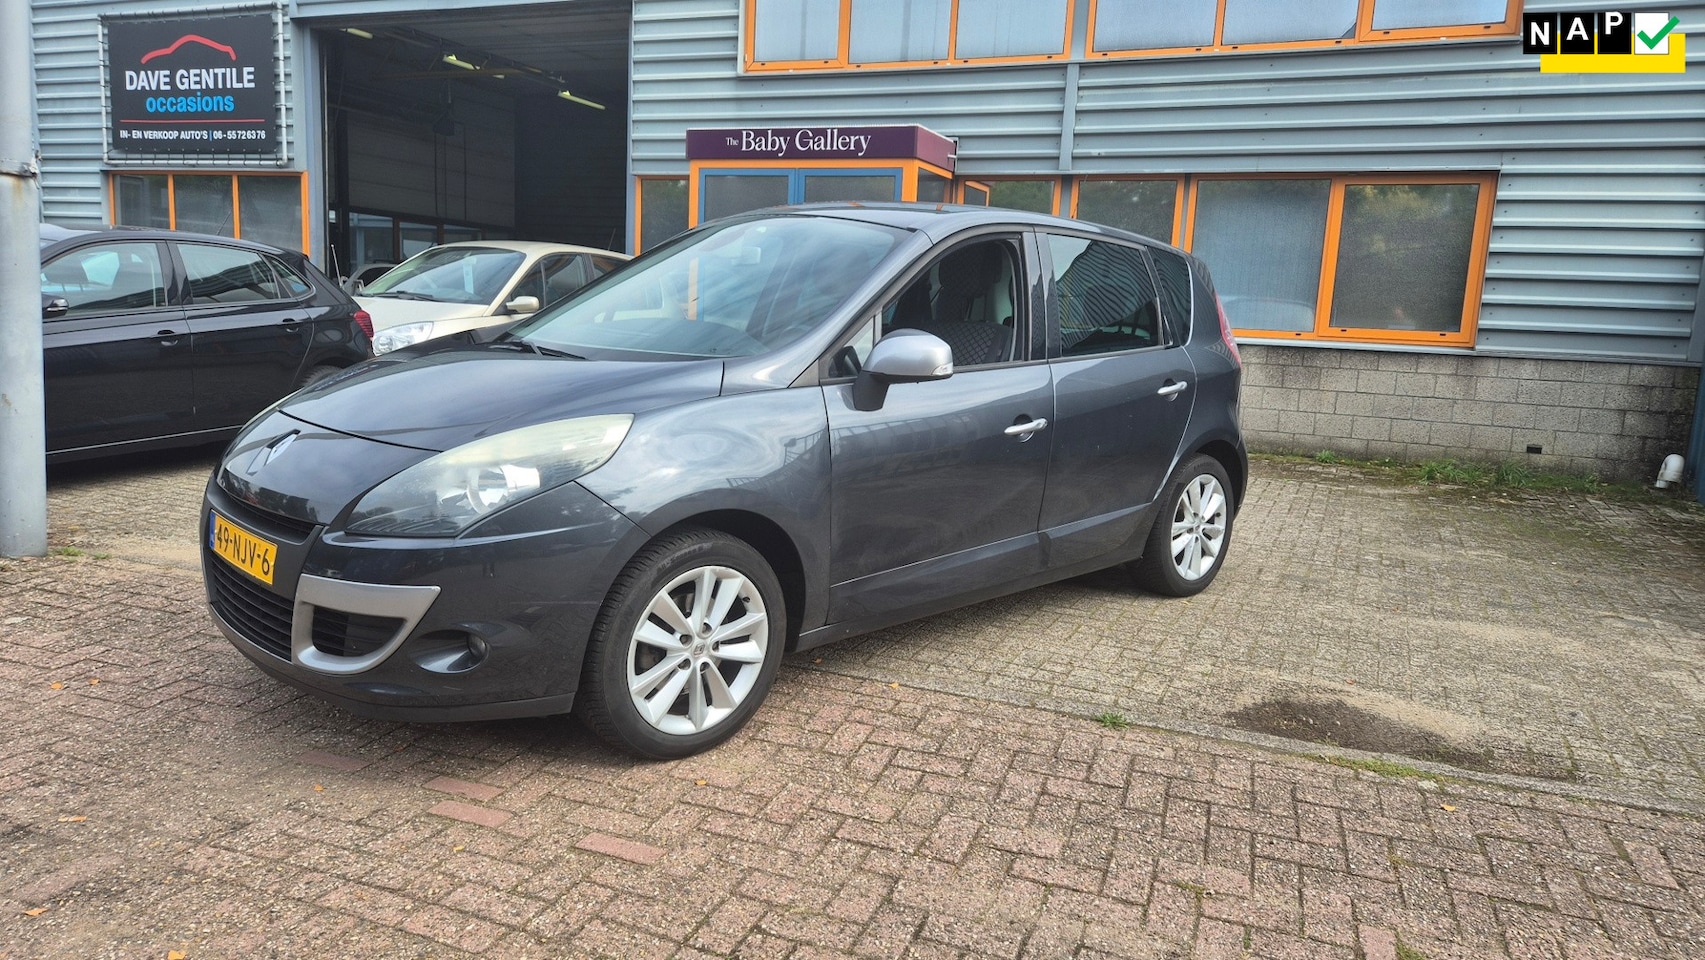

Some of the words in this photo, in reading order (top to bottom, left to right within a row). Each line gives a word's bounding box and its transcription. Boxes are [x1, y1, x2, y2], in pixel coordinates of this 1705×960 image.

[125, 70, 171, 91] DAVE
[176, 67, 255, 90] GENTILE
[146, 92, 235, 113] occasions
[120, 130, 131, 139] IN-
[132, 130, 142, 139] EN
[143, 130, 179, 140] VERKOOP
[180, 130, 208, 140] AUTO'S
[726, 137, 739, 146] The
[741, 130, 790, 157] Baby
[795, 129, 871, 157] Gallery
[217, 523, 270, 576] 49-NJV-6
